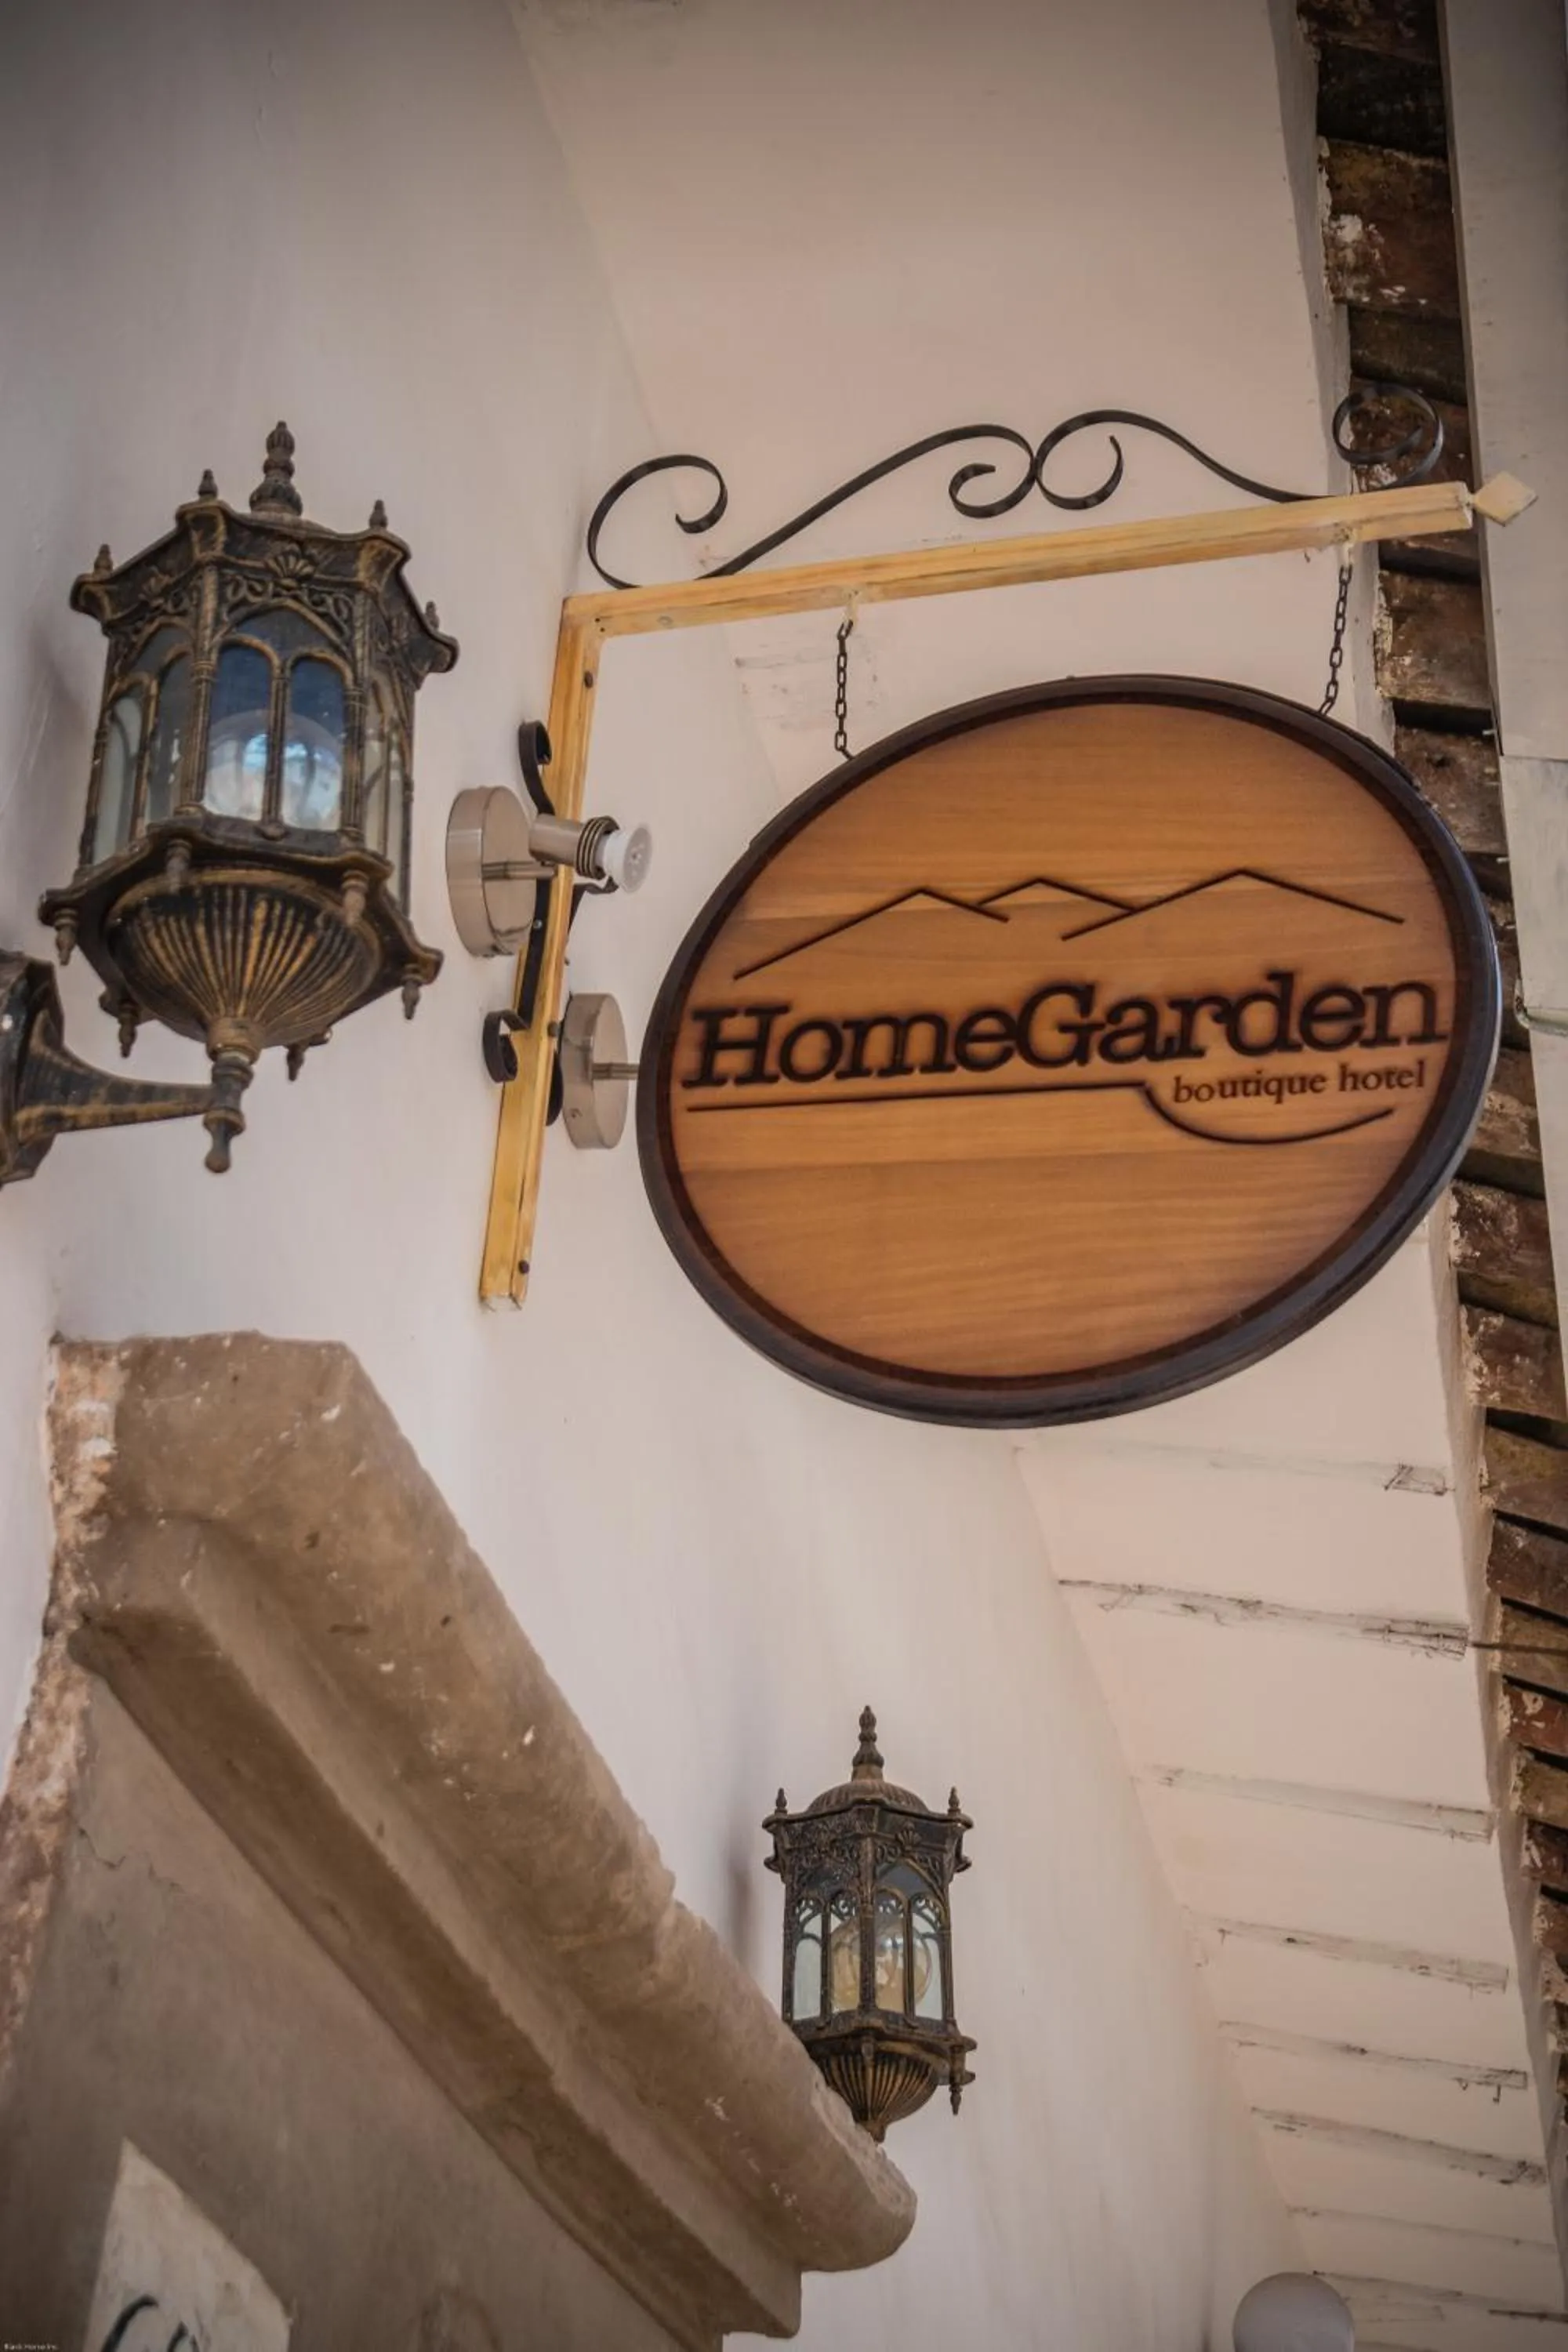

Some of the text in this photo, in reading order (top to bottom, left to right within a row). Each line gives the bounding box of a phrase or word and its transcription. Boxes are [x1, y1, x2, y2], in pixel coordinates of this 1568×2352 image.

[682, 971, 1447, 1087] HomeGarden
[1174, 1061, 1425, 1103] boutique hotel
